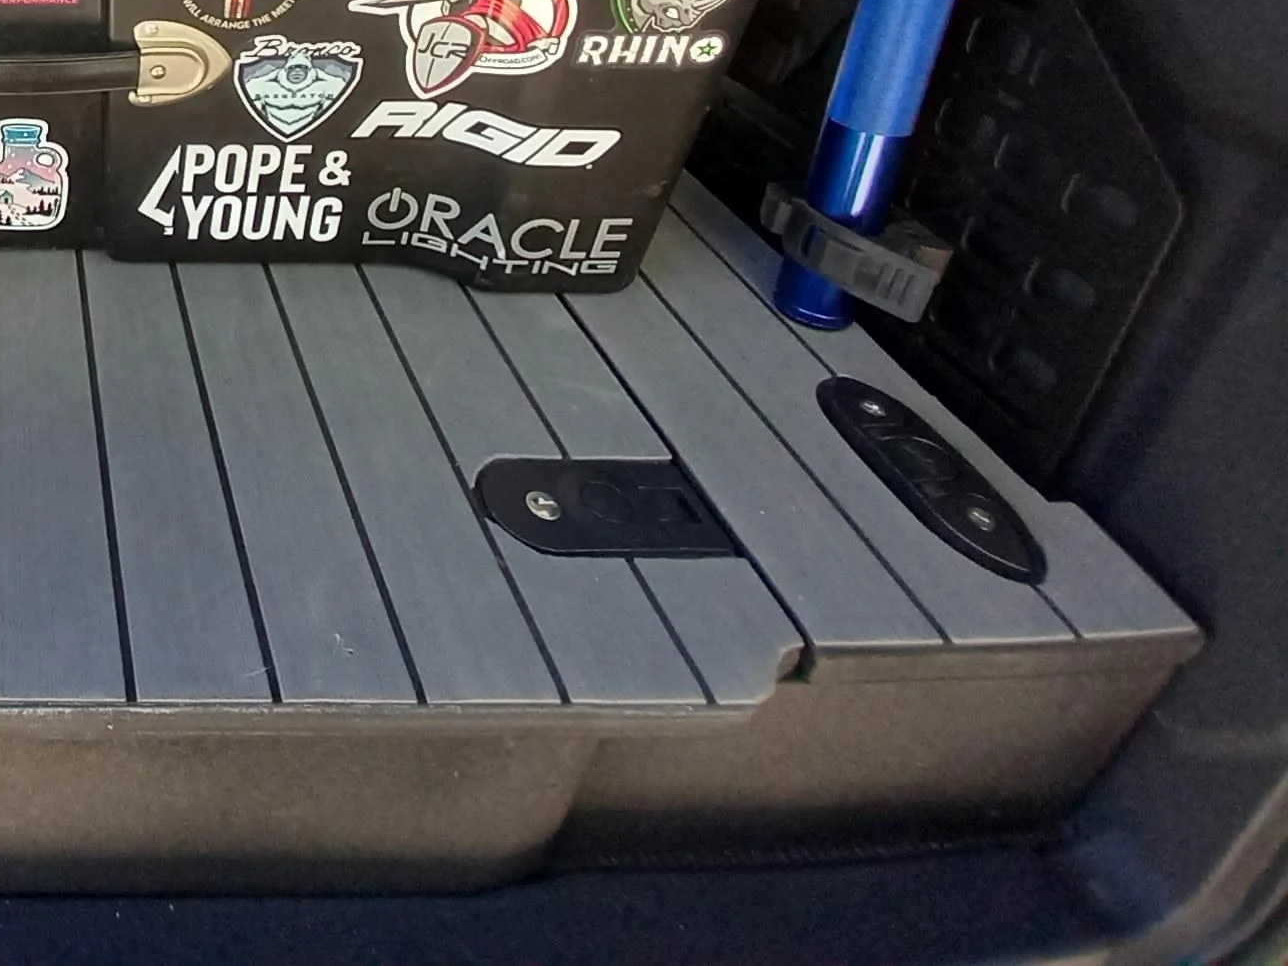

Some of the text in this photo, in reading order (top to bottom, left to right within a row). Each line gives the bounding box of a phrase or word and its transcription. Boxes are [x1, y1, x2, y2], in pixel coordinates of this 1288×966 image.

[200, 14, 250, 30] ARRANGE
[252, 15, 271, 27] THE
[418, 33, 469, 59] JCR
[351, 101, 622, 167] RIGID
[181, 144, 352, 193] POPE &
[181, 195, 344, 242] YOUNG
[367, 187, 634, 260] ORACLE
[361, 231, 619, 276] LIGHTING
